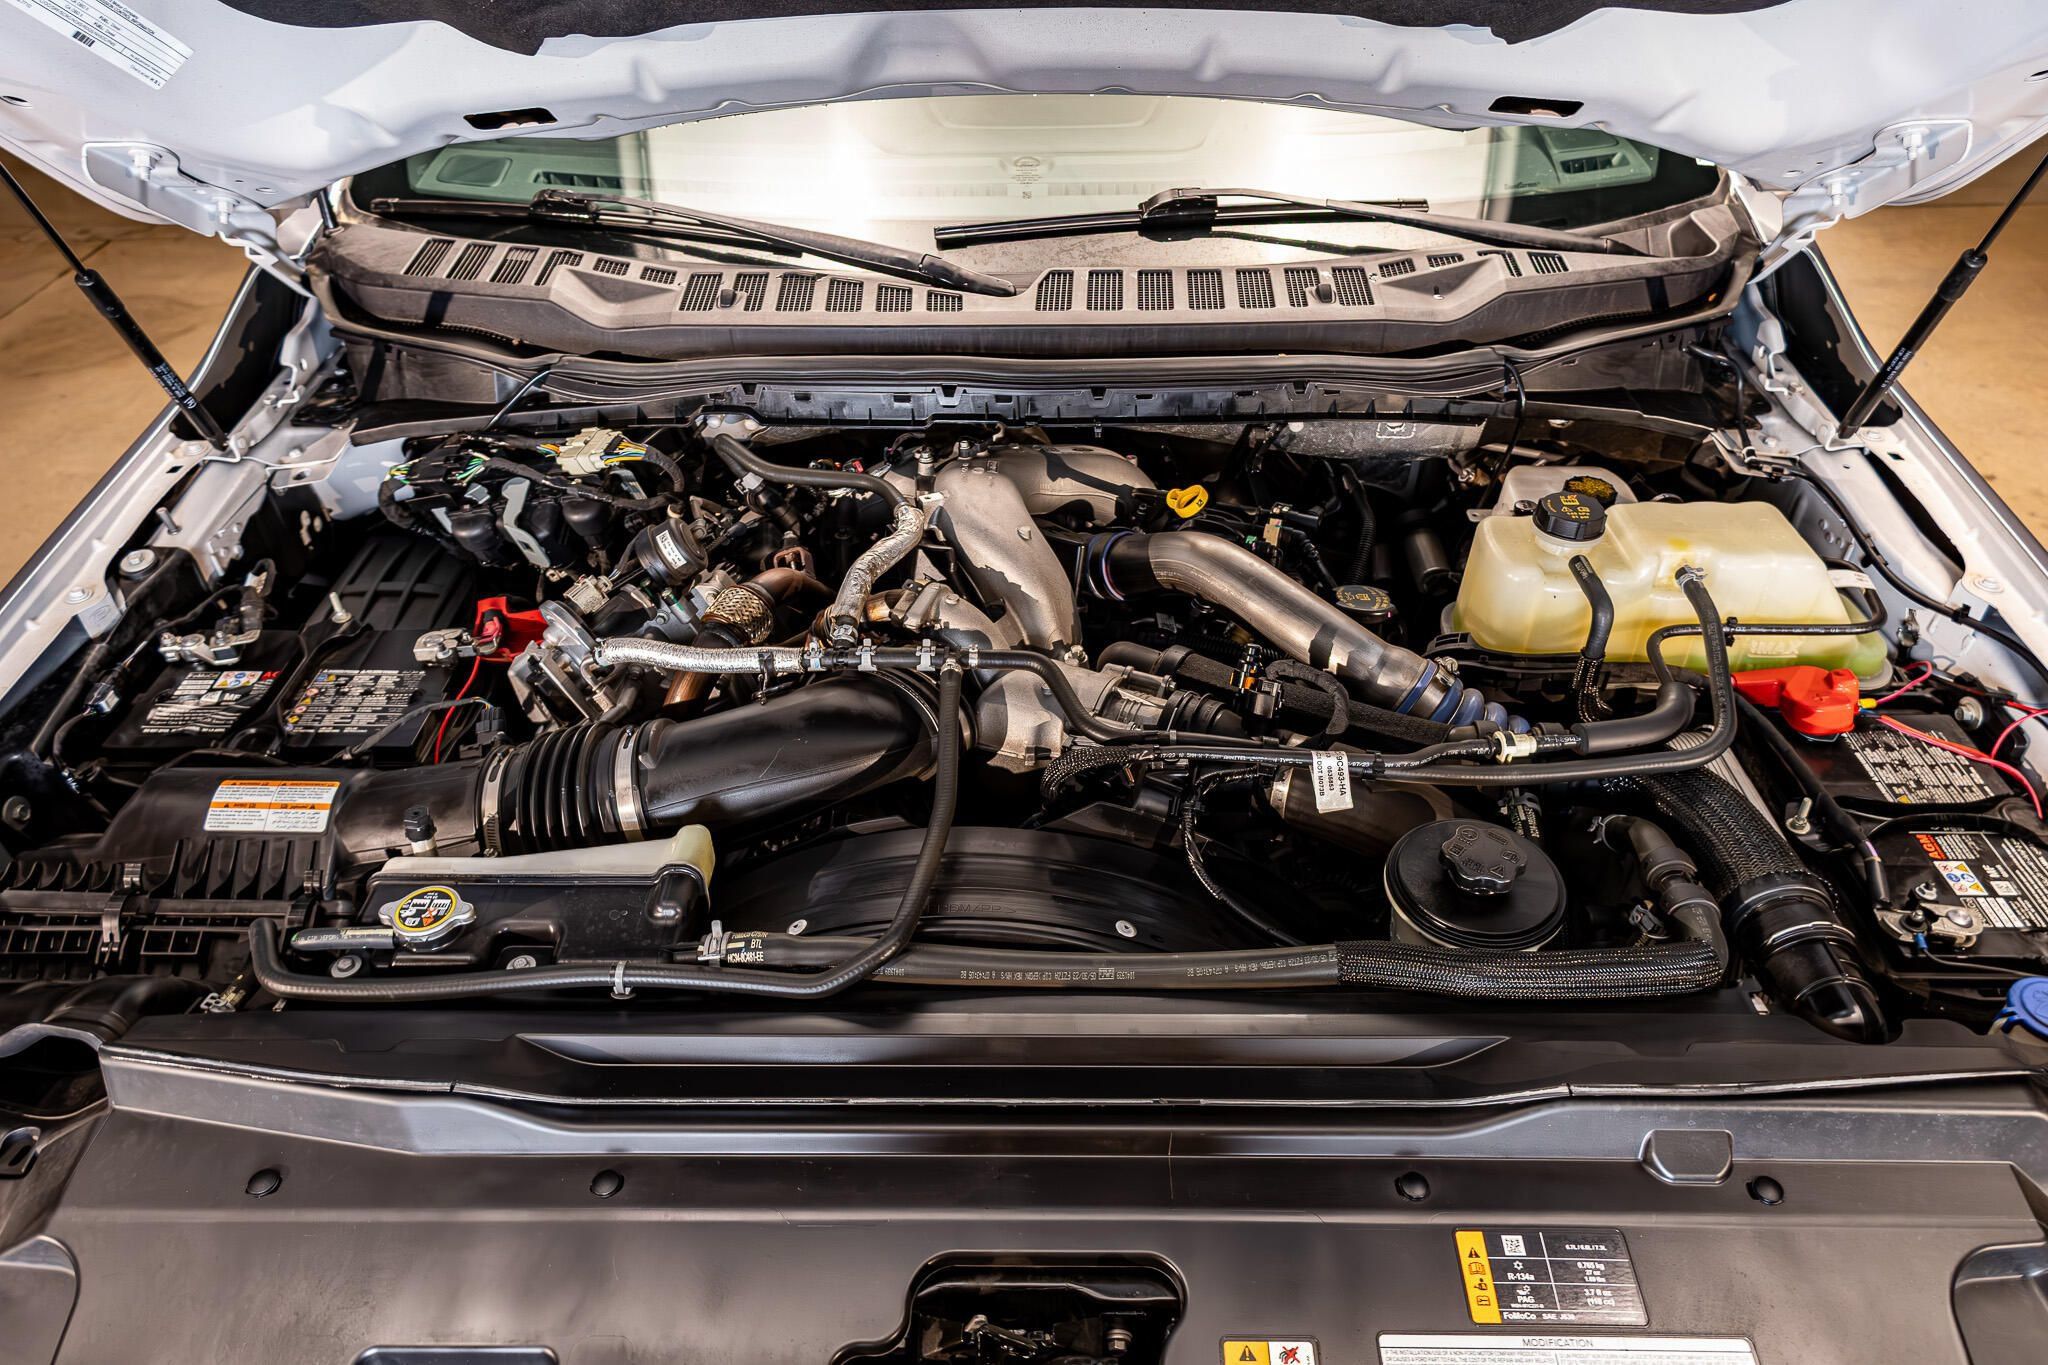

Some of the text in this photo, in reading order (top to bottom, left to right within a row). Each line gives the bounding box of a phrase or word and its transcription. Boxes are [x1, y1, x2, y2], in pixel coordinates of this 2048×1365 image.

[750, 938, 762, 948] BTL
[1507, 1272, 1535, 1281] R-134a
[1584, 1288, 1595, 1296] 3.7
[1517, 1295, 1535, 1303] PAG
[1503, 1311, 1537, 1320] FoMoCo
[1521, 1338, 1594, 1347] MODIFICATION
